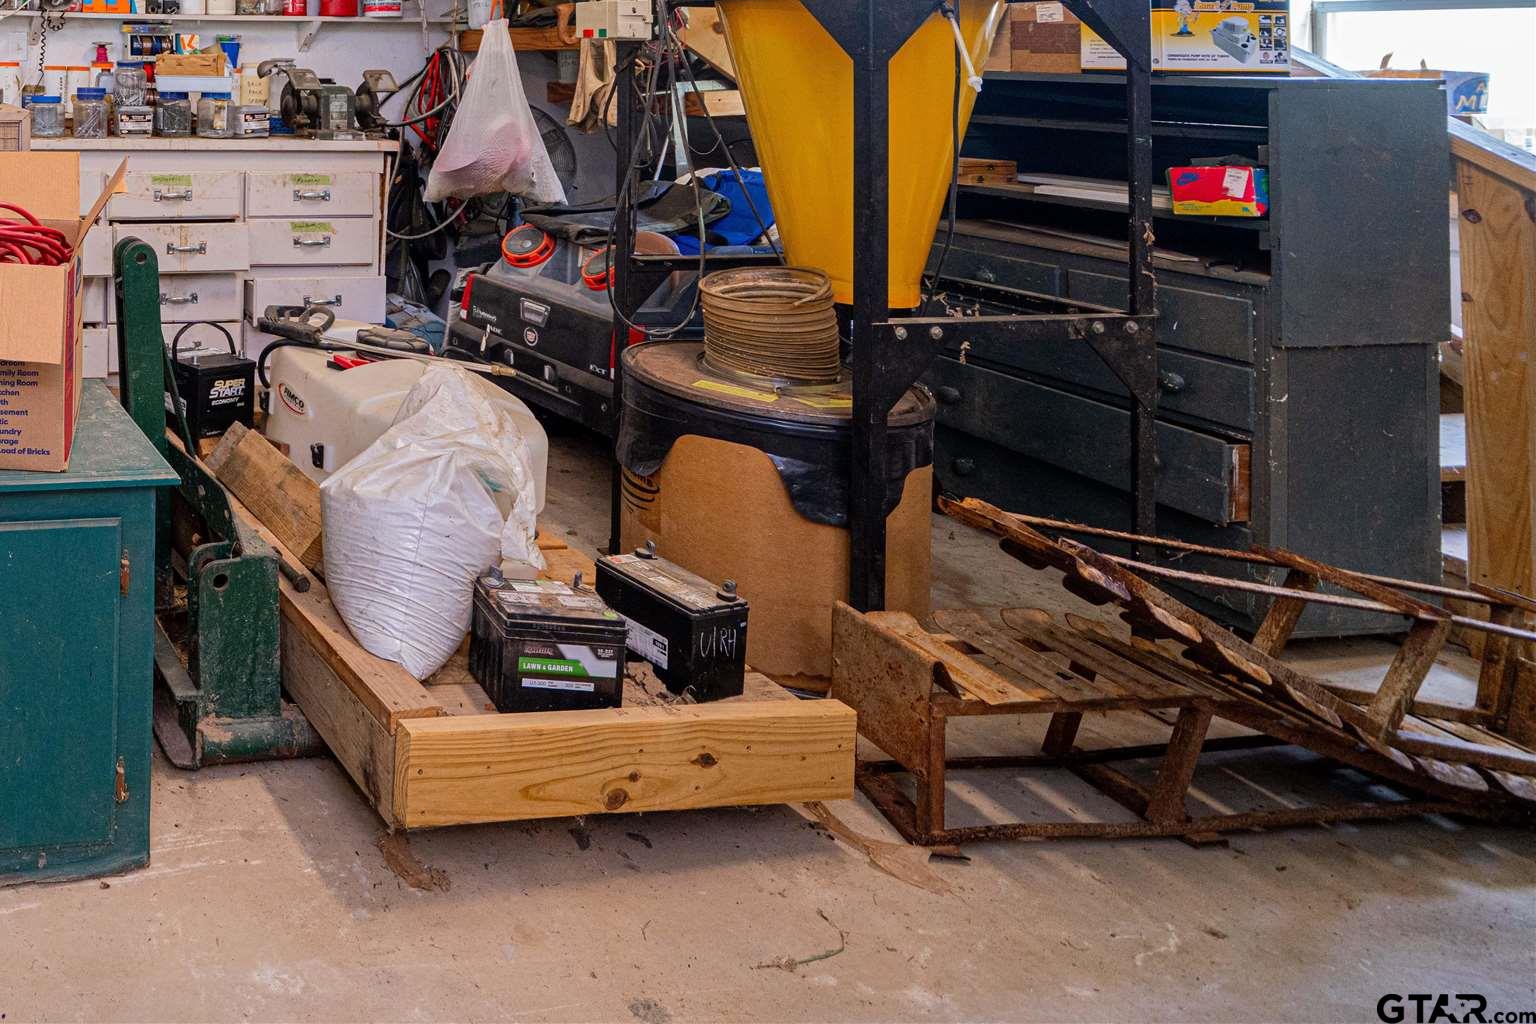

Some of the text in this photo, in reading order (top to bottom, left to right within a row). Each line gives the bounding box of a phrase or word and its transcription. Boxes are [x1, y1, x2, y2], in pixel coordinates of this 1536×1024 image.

[17, 369, 39, 377] Room
[16, 379, 38, 387] Room
[214, 378, 246, 388] SUPER
[209, 387, 244, 399] START
[284, 387, 305, 408] FIMCO
[211, 397, 240, 406] ECONOMY
[523, 662, 541, 670] LAWN
[547, 663, 573, 672] GARDEN
